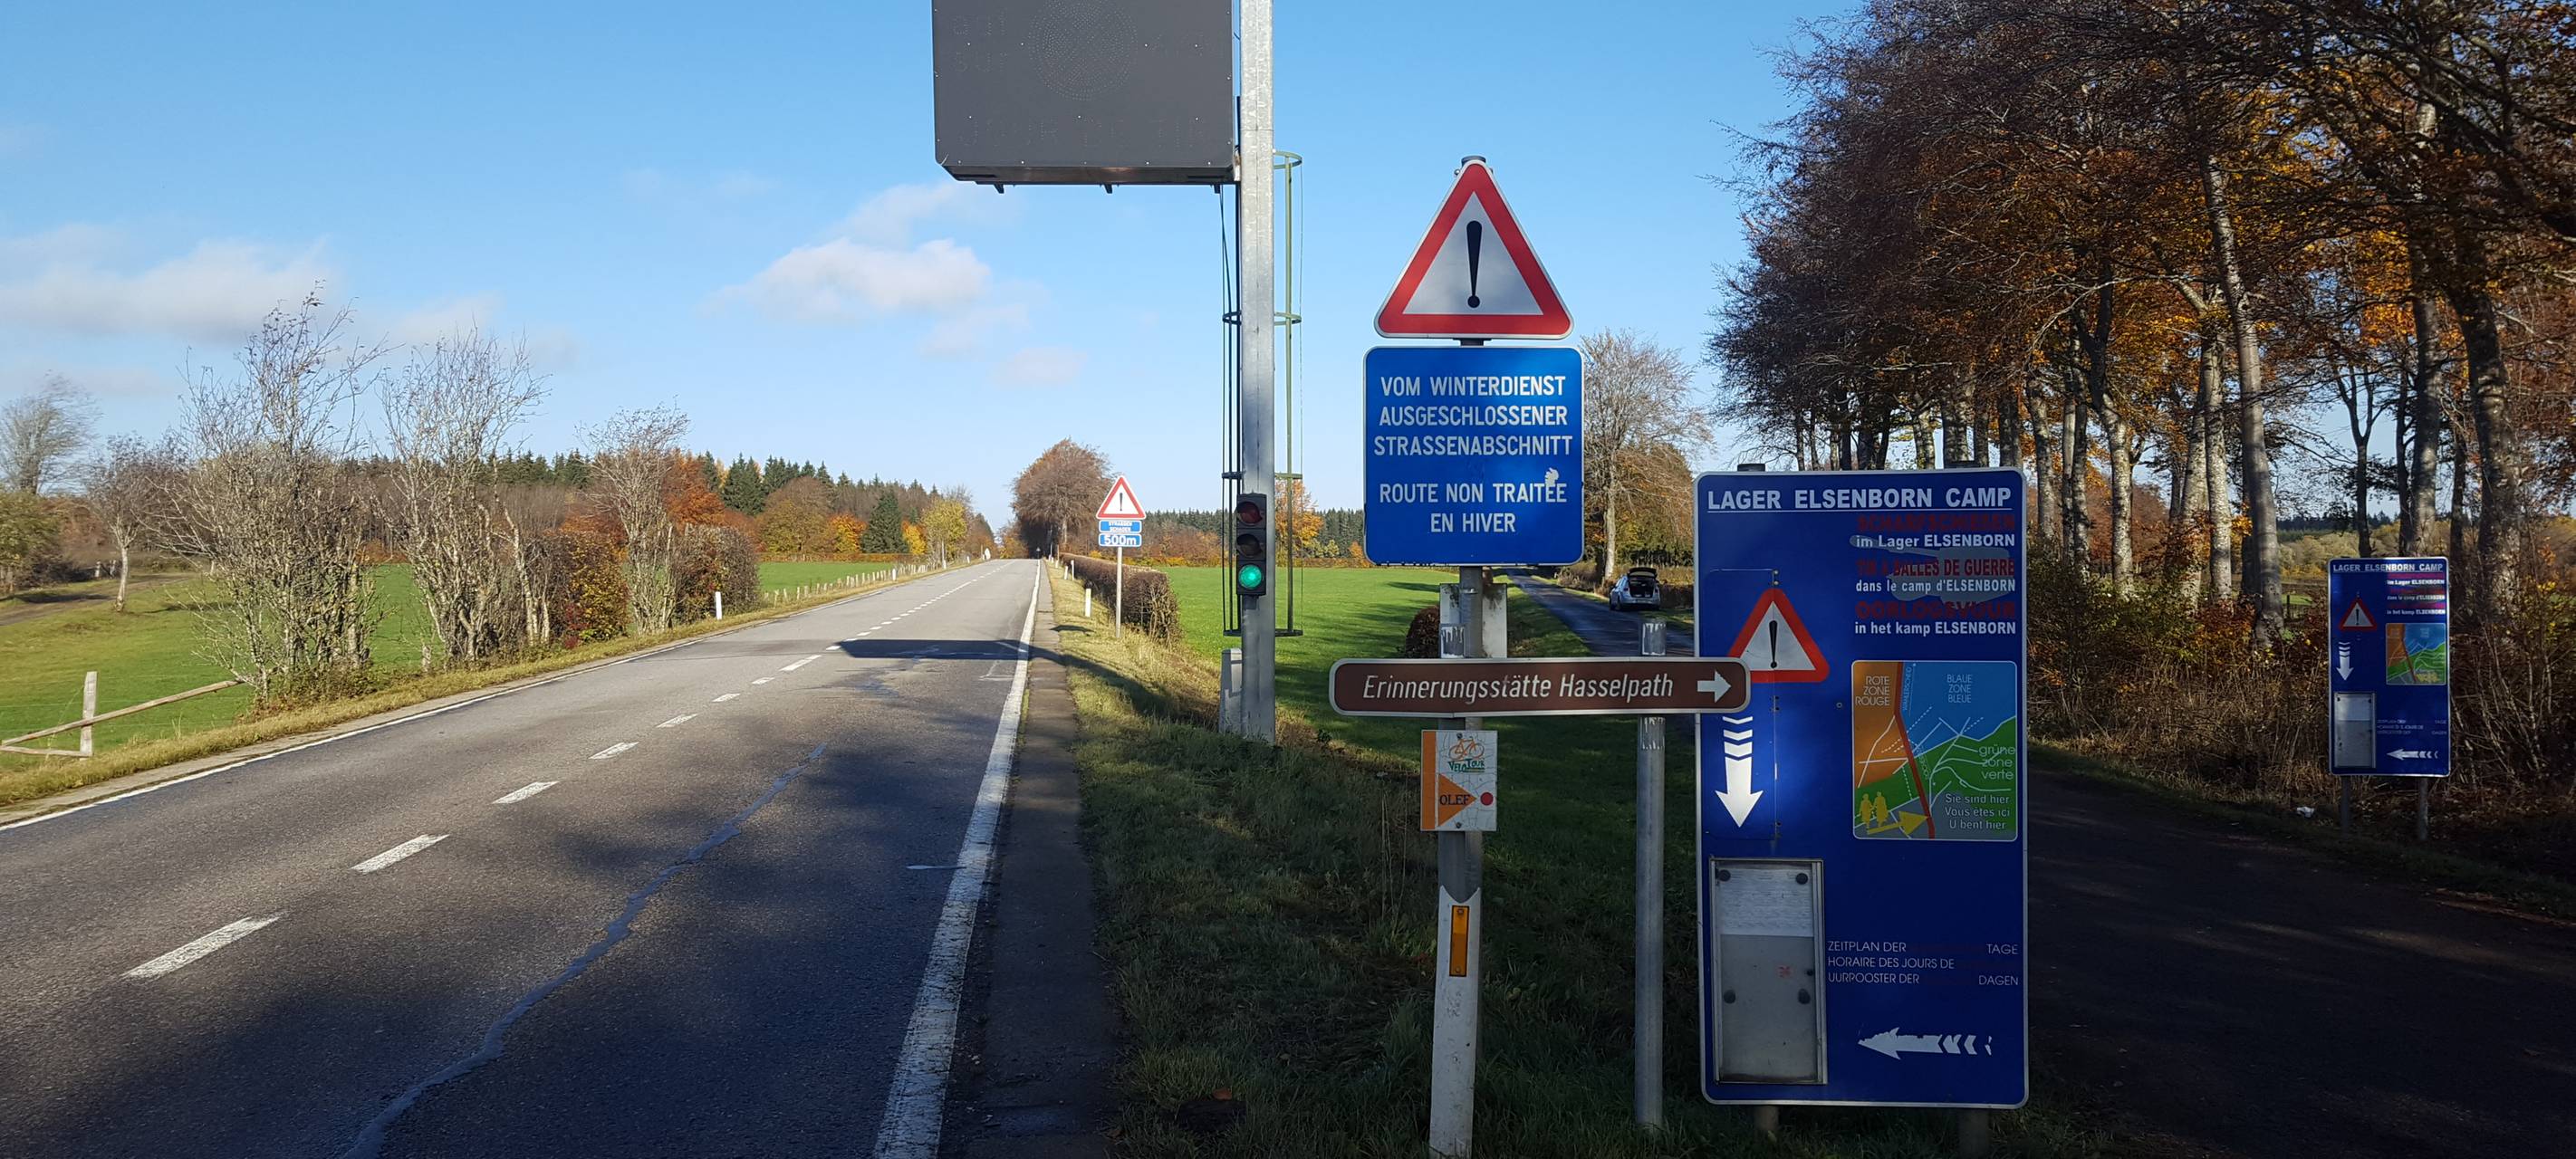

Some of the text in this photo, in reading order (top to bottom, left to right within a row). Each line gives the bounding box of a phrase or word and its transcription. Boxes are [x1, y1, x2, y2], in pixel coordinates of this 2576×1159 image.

[1380, 376, 1565, 396] VOM WINTERDIENST
[1379, 406, 1567, 426] AUSGESCHLOSSENER
[1374, 436, 1572, 455] STRASSENABSCHNITT
[1379, 484, 1438, 503] ROUTE
[1446, 484, 1483, 503] NON
[1707, 487, 2012, 510] LAGER ELSENBORN CAMP
[1431, 513, 1515, 532] EN HIVER
[1103, 534, 1137, 545] 500m
[1857, 534, 2015, 550] im Lager ELSENBORN
[1944, 559, 1960, 576] DE
[1964, 559, 2015, 576] GUERRE
[2365, 563, 2415, 571] ELSENBORN
[1856, 580, 2015, 594] dans le camp d'ELSENBORN
[1855, 621, 2016, 637] in het kamp ELSENBORN
[1866, 675, 1890, 685] ROTE
[1947, 675, 1973, 683] BLAUE
[1363, 673, 1673, 704] Erinnerungsstätte Hasselpath
[1863, 686, 1890, 695] ZONE
[1948, 685, 1971, 693] ZONE
[1856, 696, 1890, 706] ROUGE
[1948, 694, 1971, 703] BLEUE
[1979, 743, 2015, 757] grüne
[1983, 759, 2013, 767] zone
[1981, 770, 2014, 780] verte
[1946, 793, 2009, 803] Sie sind hier
[1945, 807, 1970, 816] Vous
[1998, 809, 2010, 817] ici
[1949, 819, 2006, 829] U bent hier
[1828, 941, 1879, 952] ZEITPLAN
[1883, 942, 1907, 953] DER
[1986, 944, 2018, 954] TAGE
[1828, 957, 1876, 968] HORAIRE
[1879, 957, 1898, 968] DES
[1902, 958, 1937, 969] JOURS
[1940, 959, 1955, 969] DE
[1899, 973, 1919, 984] DER
[1978, 975, 2018, 986] DAGEN
